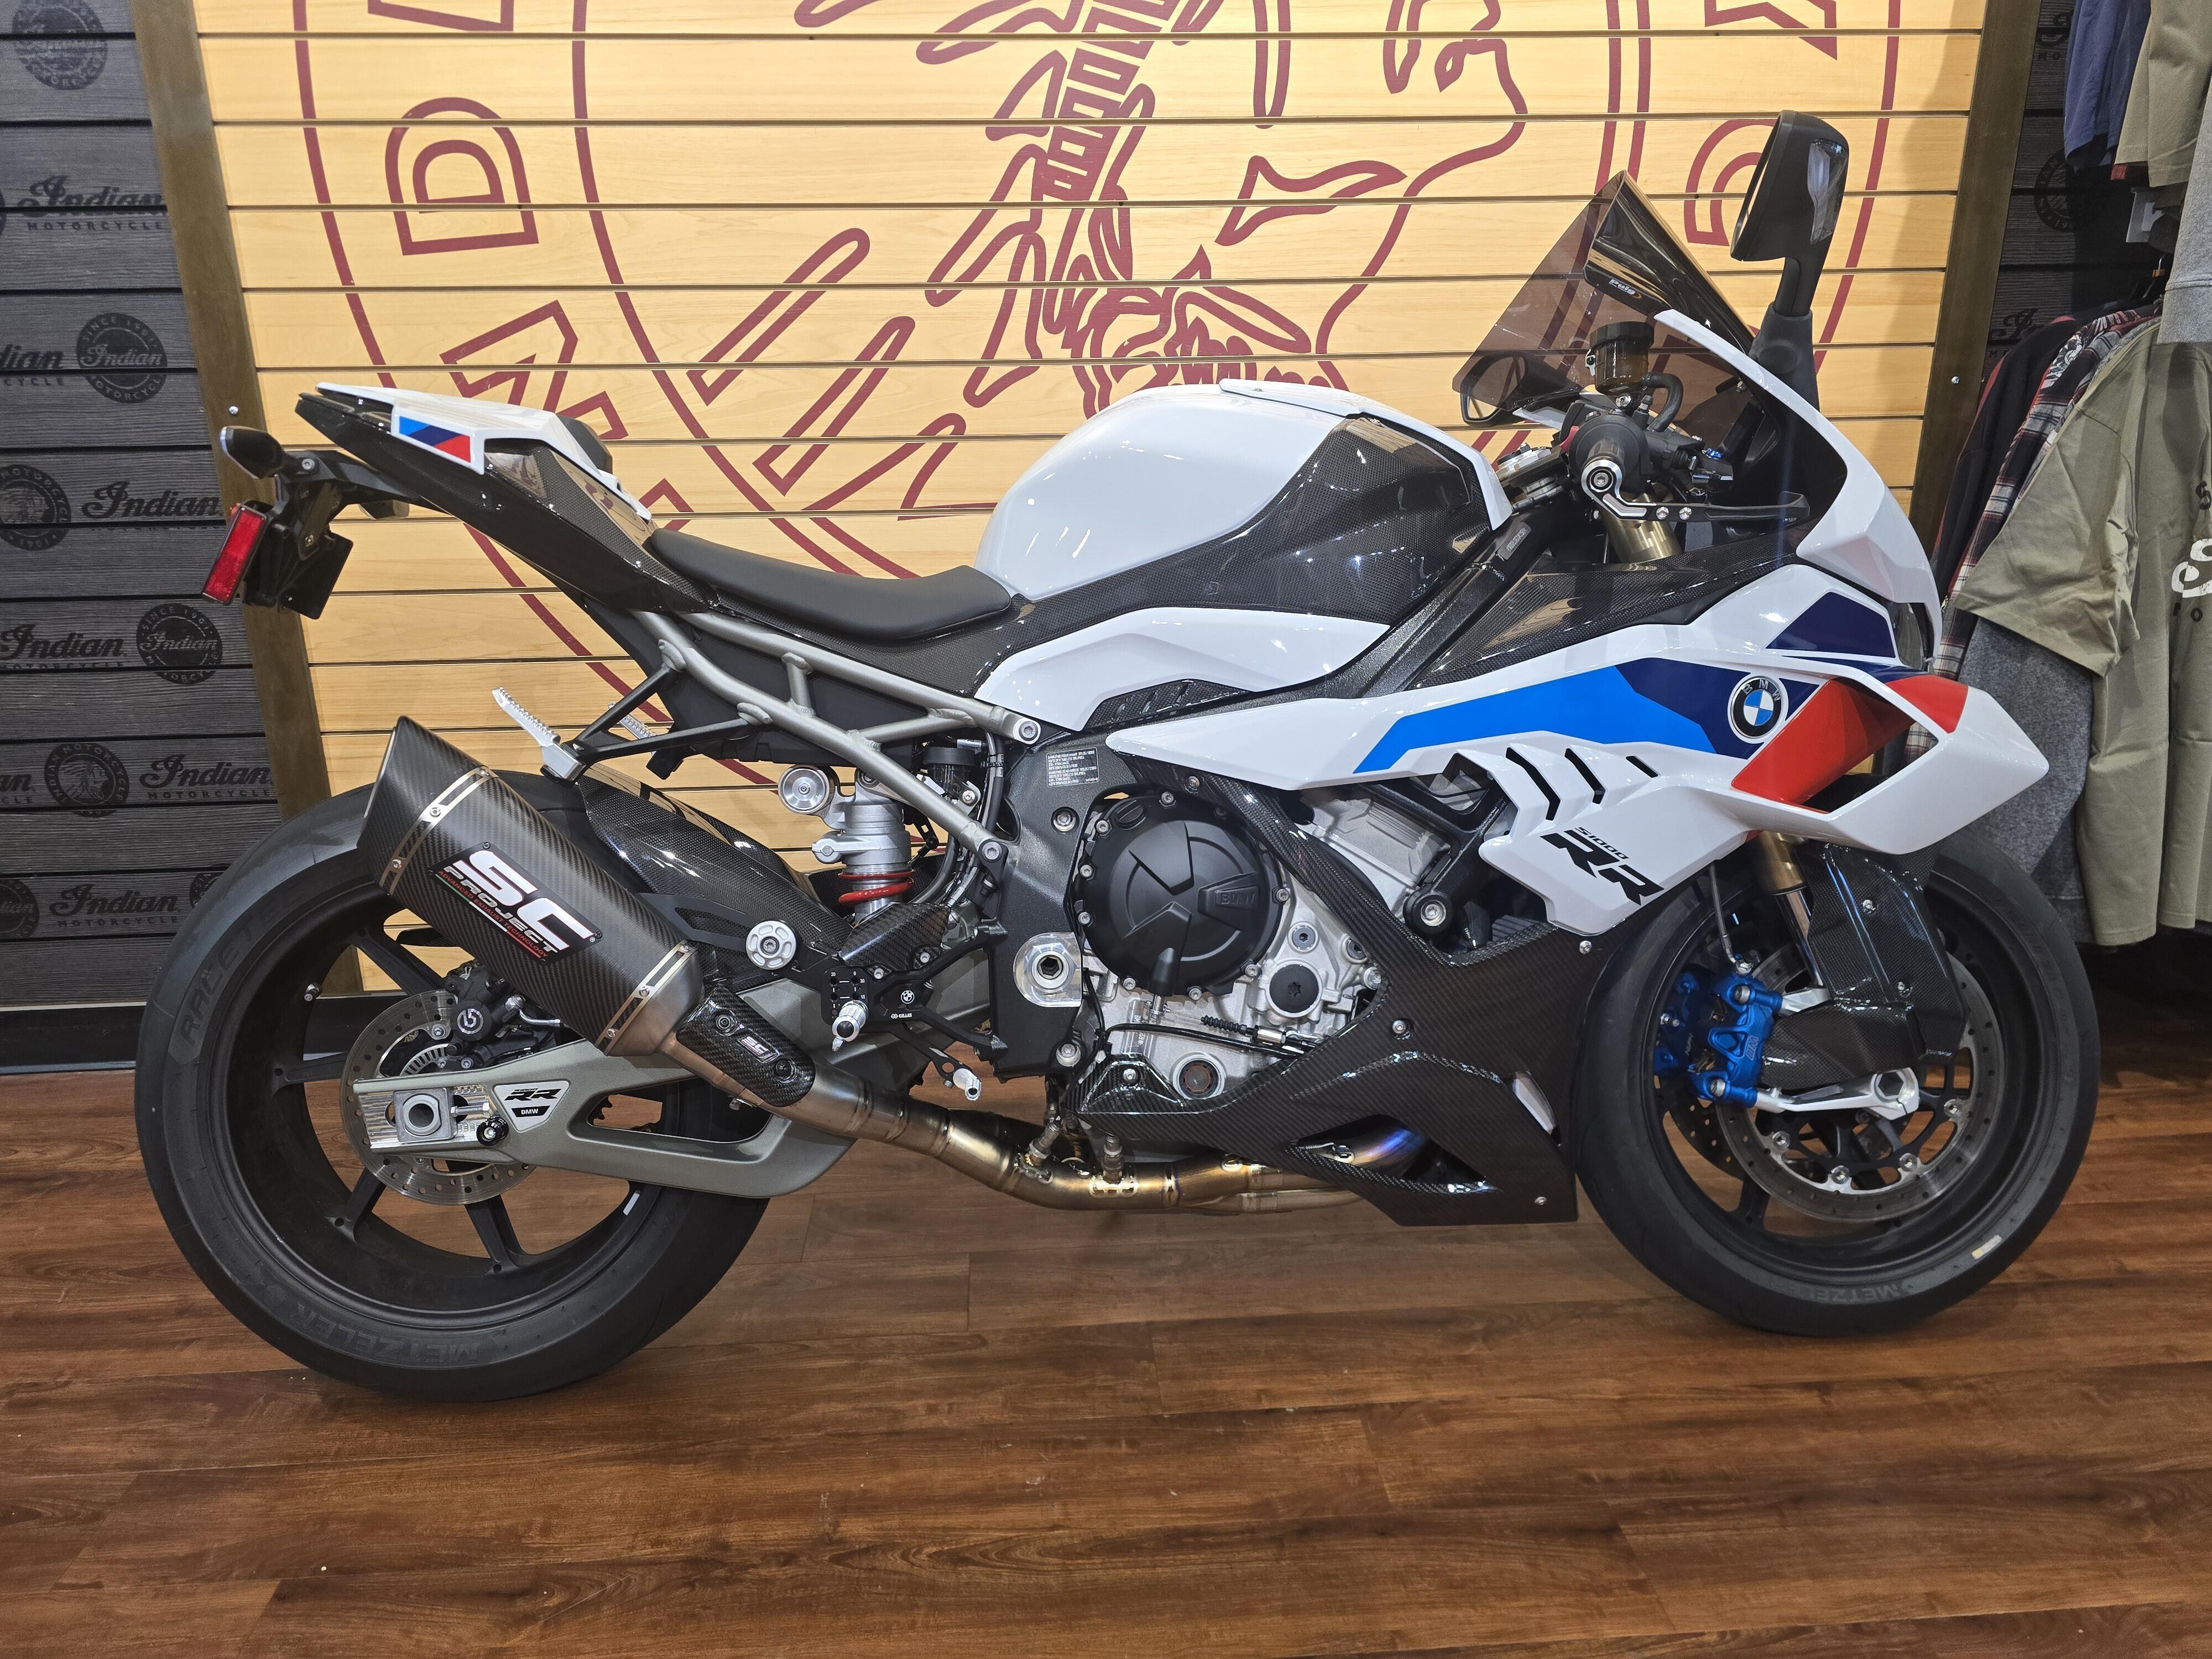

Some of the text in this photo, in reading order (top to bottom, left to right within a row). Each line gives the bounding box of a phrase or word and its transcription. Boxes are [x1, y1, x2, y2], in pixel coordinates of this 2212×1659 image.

[80, 343, 162, 367] Indian
[82, 482, 220, 519] Indian
[0, 623, 125, 660] Indian
[139, 631, 218, 651] Indian
[1743, 679, 1781, 702] BMW
[139, 754, 270, 789] Indian
[149, 790, 271, 799] MOTORCYCLE
[1574, 827, 1629, 860] S1000
[1540, 829, 1665, 905] RR
[49, 885, 178, 916] Indian
[438, 870, 548, 957] ADVANCED EXHAUST TECHNOLOGY
[443, 865, 559, 953] PROJECT
[452, 849, 595, 951] SC
[1220, 893, 1255, 905] BMW
[57, 916, 178, 927] MOTORCYCLE
[504, 1088, 562, 1101] RR
